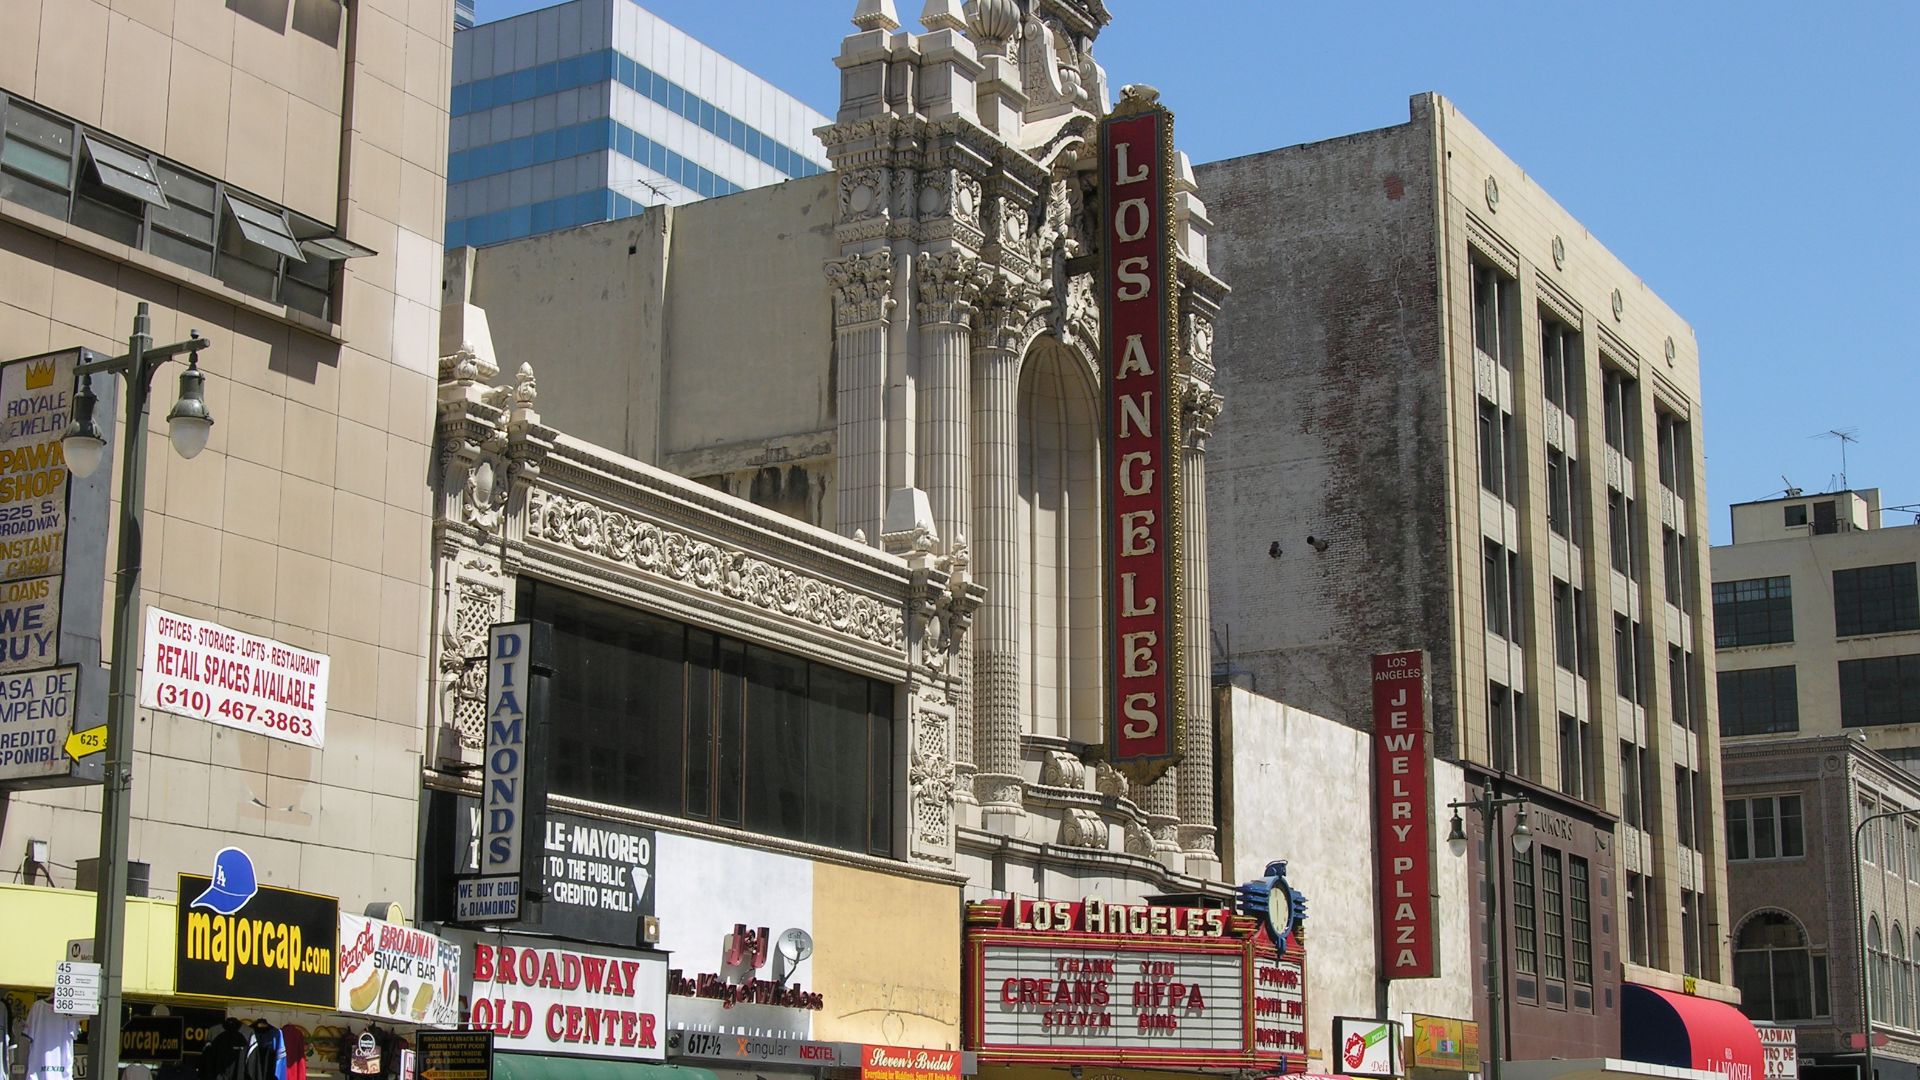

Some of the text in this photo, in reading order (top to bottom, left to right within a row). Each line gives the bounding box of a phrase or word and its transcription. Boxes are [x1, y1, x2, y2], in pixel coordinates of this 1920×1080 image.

[8, 391, 66, 418] ROYALE
[9, 411, 69, 438] EWELRY
[1115, 142, 1157, 740] LOS ANGELES
[0, 468, 65, 503] SHOP
[41, 500, 55, 514] S.
[0, 514, 60, 536] ROADWAY
[0, 534, 62, 560] NSTANT
[6, 556, 49, 578] CASH
[0, 604, 44, 634] WE
[158, 616, 320, 677] OFFICES STORAGE LOFTS RESTAURANT
[1375, 669, 1421, 681] ANGELES
[1387, 658, 1407, 668] LOS
[0, 673, 72, 700] ASA DE
[157, 643, 316, 711] RETAIL SPACES AVAILABLE
[0, 696, 67, 723] MPEÑO
[157, 683, 313, 737] (310) 467-3863
[0, 729, 56, 749] REDITO
[80, 734, 98, 747] 625
[488, 633, 523, 865] DIAMONDS
[544, 821, 565, 851] LE
[1384, 688, 1418, 967] JEWELRY PLAZA
[550, 856, 564, 877] TO
[567, 858, 586, 881] THE
[588, 862, 627, 887] PUBLIC
[459, 881, 519, 898] WE BUY GOLD
[553, 881, 633, 913] CREDITO FACIL!
[460, 900, 516, 916] & DIAMONDS
[187, 911, 330, 986] majorcap.com
[380, 925, 458, 973] BROADWAY PEPS
[57, 974, 71, 985] 68
[58, 962, 72, 973] 45
[373, 951, 436, 982] SNACK BAR
[474, 943, 639, 997] BROADWAY
[1056, 957, 1175, 978] THANK YOU
[56, 987, 75, 998] 330
[56, 999, 74, 1010] 368
[1001, 977, 1205, 1010] CREANS HFPA
[472, 998, 533, 1039] OLD
[545, 1003, 657, 1049] CENTER
[1043, 1011, 1177, 1030] STEVEN BING
[1757, 1030, 1793, 1042] OADWAY
[745, 1039, 788, 1060] cingular
[800, 1045, 835, 1061] NEXTEL
[870, 1048, 953, 1072] Steven's Bridal
[1764, 1048, 1794, 1061] TRO DE
[1371, 1060, 1389, 1073] Deli
